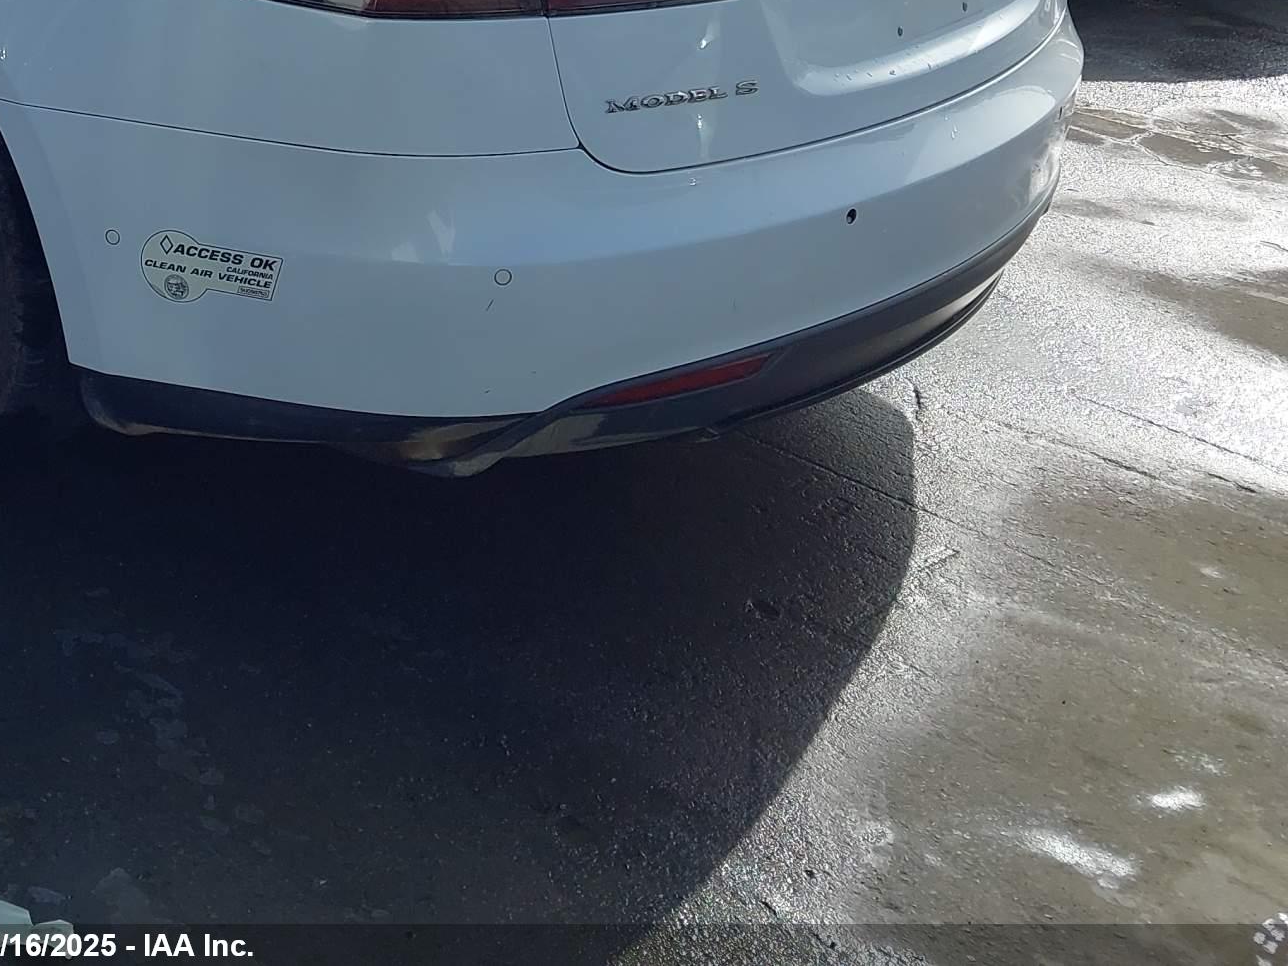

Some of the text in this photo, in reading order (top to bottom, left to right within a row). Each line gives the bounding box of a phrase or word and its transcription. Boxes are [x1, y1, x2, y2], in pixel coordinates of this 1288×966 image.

[605, 79, 760, 114] MODEL S
[173, 243, 279, 272] ACCESS OK
[144, 259, 273, 289] CLEAN AIR VEHICLE
[226, 266, 274, 280] CALIFORNIA
